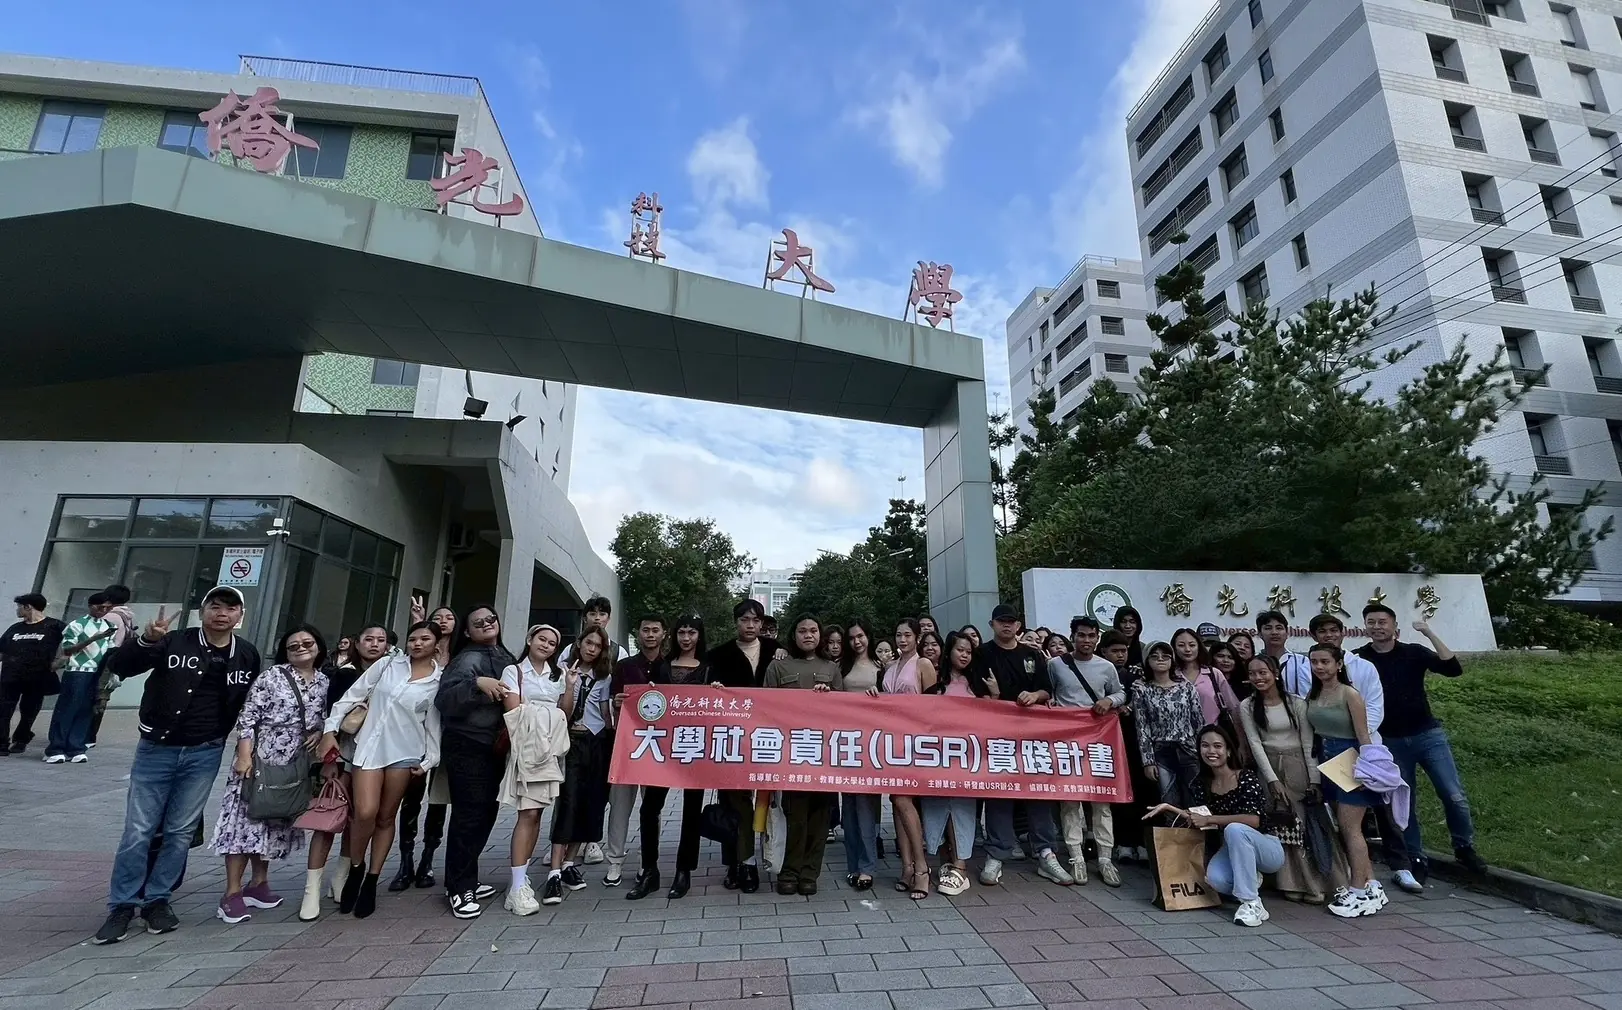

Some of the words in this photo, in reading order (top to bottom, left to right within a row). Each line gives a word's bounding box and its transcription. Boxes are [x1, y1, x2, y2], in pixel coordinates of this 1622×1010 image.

[168, 654, 199, 669] DIC
[226, 670, 252, 686] KIES
[669, 694, 754, 711] 僑光科技大學
[722, 710, 752, 719] University
[1170, 881, 1206, 898] FILA
